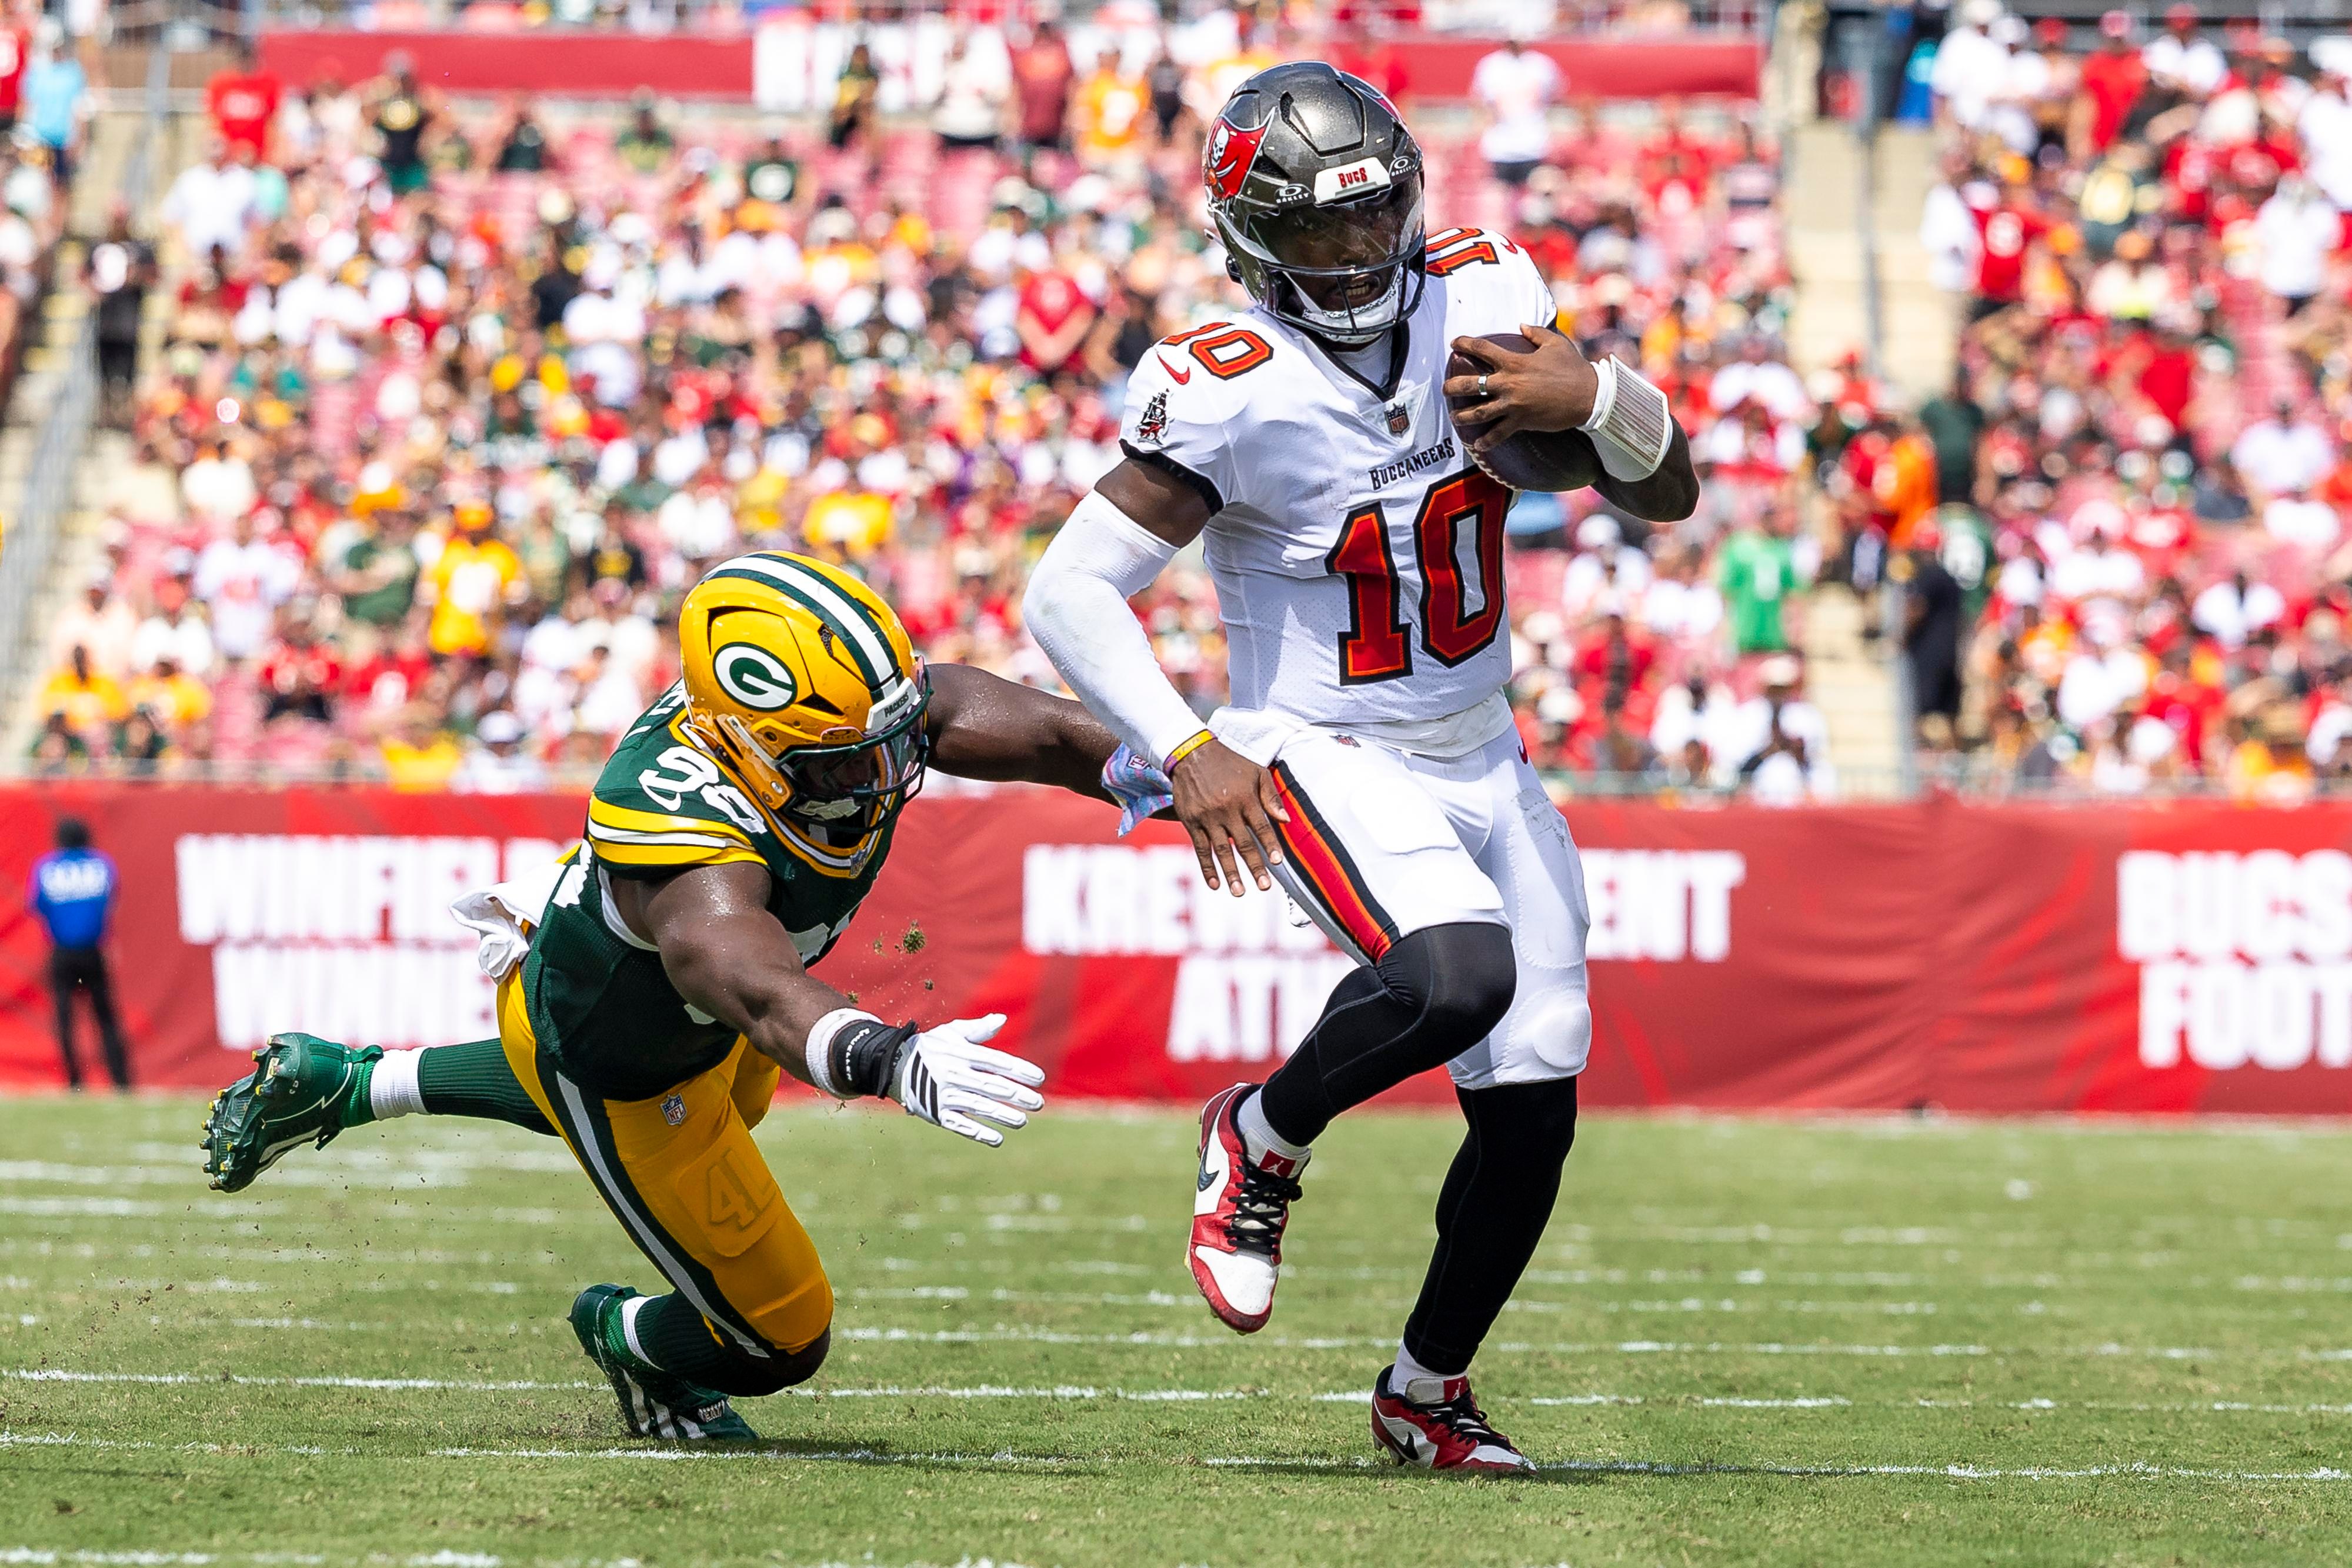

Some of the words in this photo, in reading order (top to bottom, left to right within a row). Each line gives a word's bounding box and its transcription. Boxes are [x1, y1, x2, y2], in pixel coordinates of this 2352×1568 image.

[1337, 167, 1368, 188] BUCS
[1368, 437, 1456, 491] BUCCANEERS
[1325, 463, 1513, 686] 10
[715, 643, 796, 710] G
[884, 692, 909, 718] PACKERS
[668, 1103, 685, 1122] NFL
